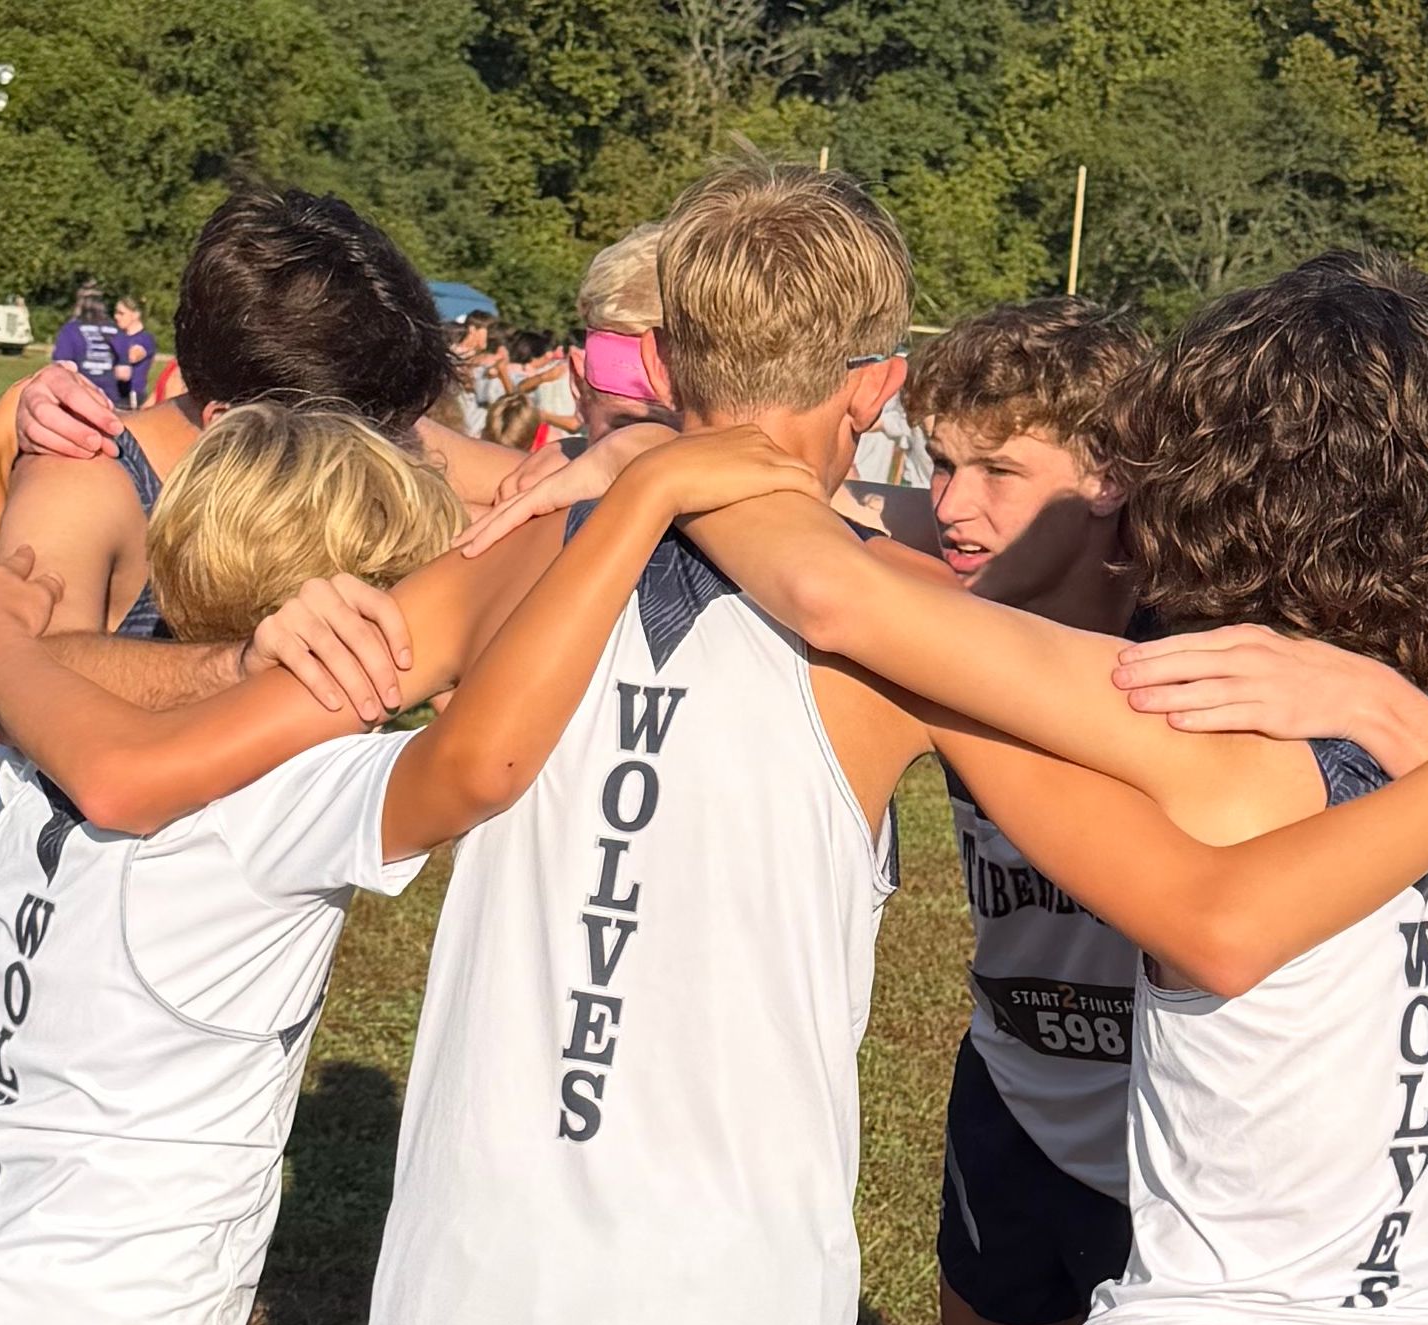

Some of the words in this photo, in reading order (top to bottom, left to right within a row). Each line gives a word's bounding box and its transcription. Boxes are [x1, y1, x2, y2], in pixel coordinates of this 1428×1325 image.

[557, 681, 688, 1143] WOLVES
[1011, 990, 1059, 1008] START
[1058, 984, 1078, 1009] 2
[1080, 996, 1134, 1014] FINISH
[1036, 1011, 1125, 1056] 598
